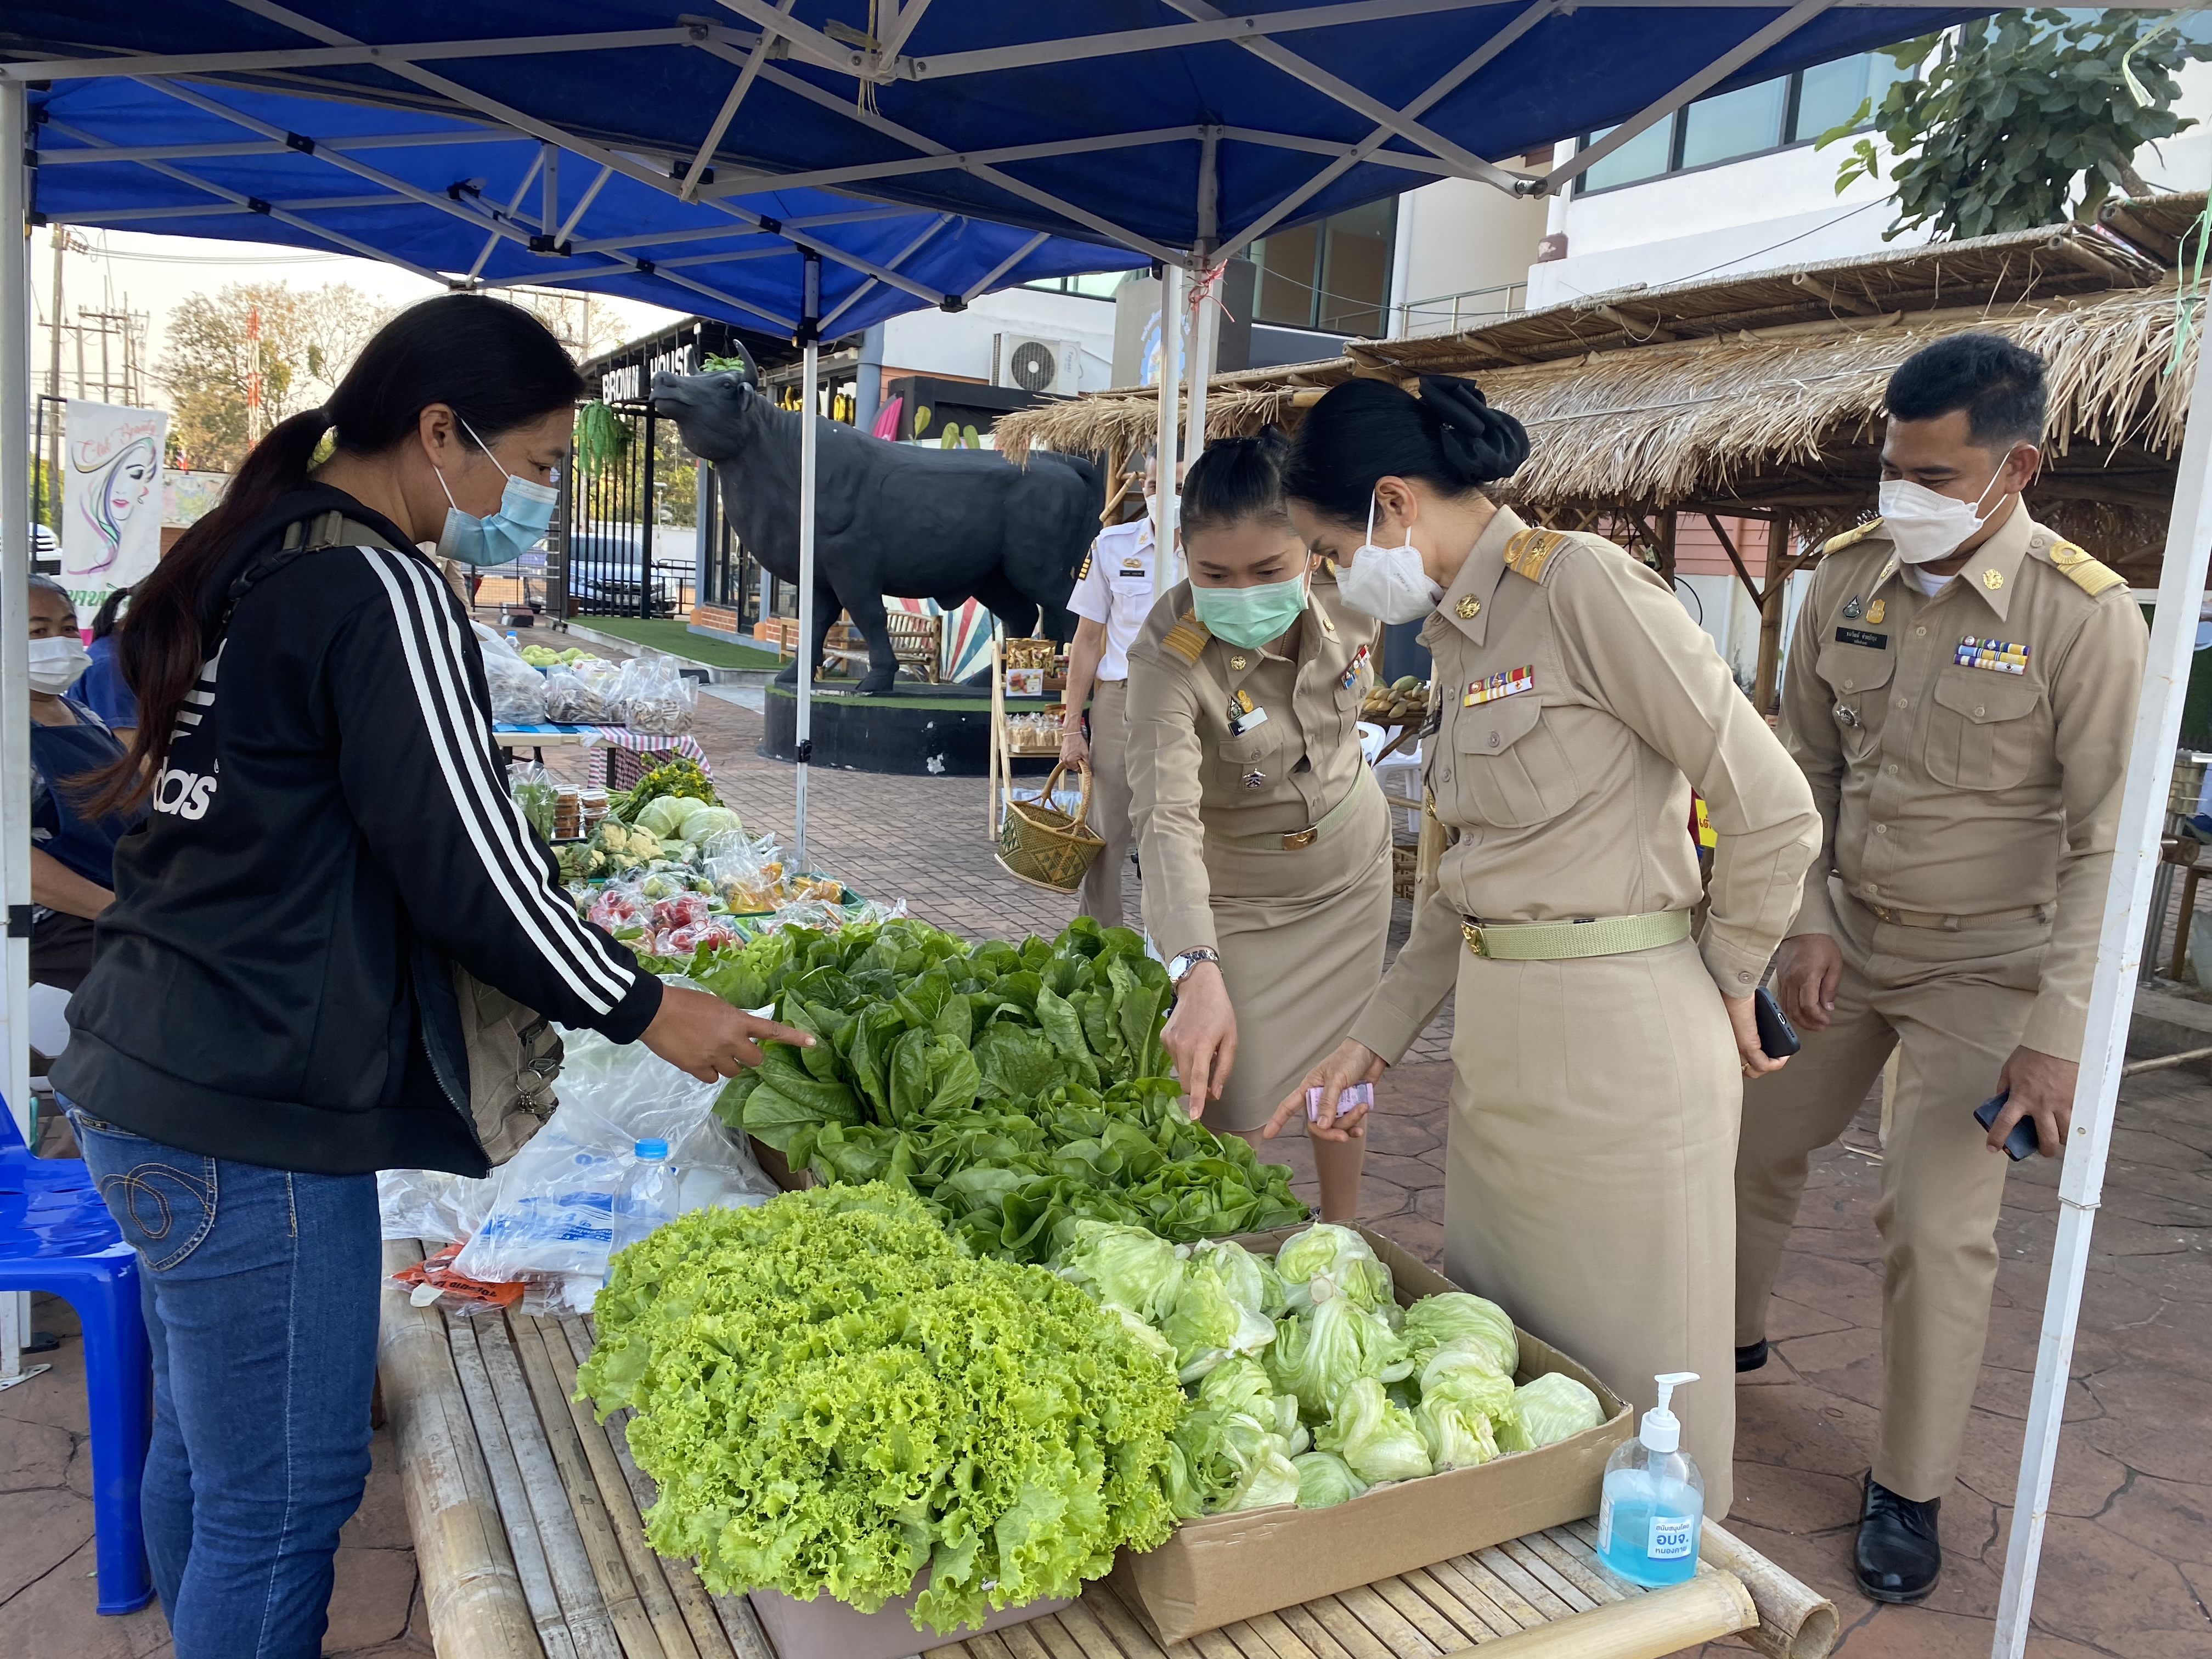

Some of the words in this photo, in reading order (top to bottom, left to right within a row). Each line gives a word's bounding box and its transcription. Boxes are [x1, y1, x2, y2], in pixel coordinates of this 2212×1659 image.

[602, 364, 639, 405] BROWN
[1656, 1524, 1690, 1532] สนับสนุนโดย
[1657, 1534, 1689, 1545] อบจ.
